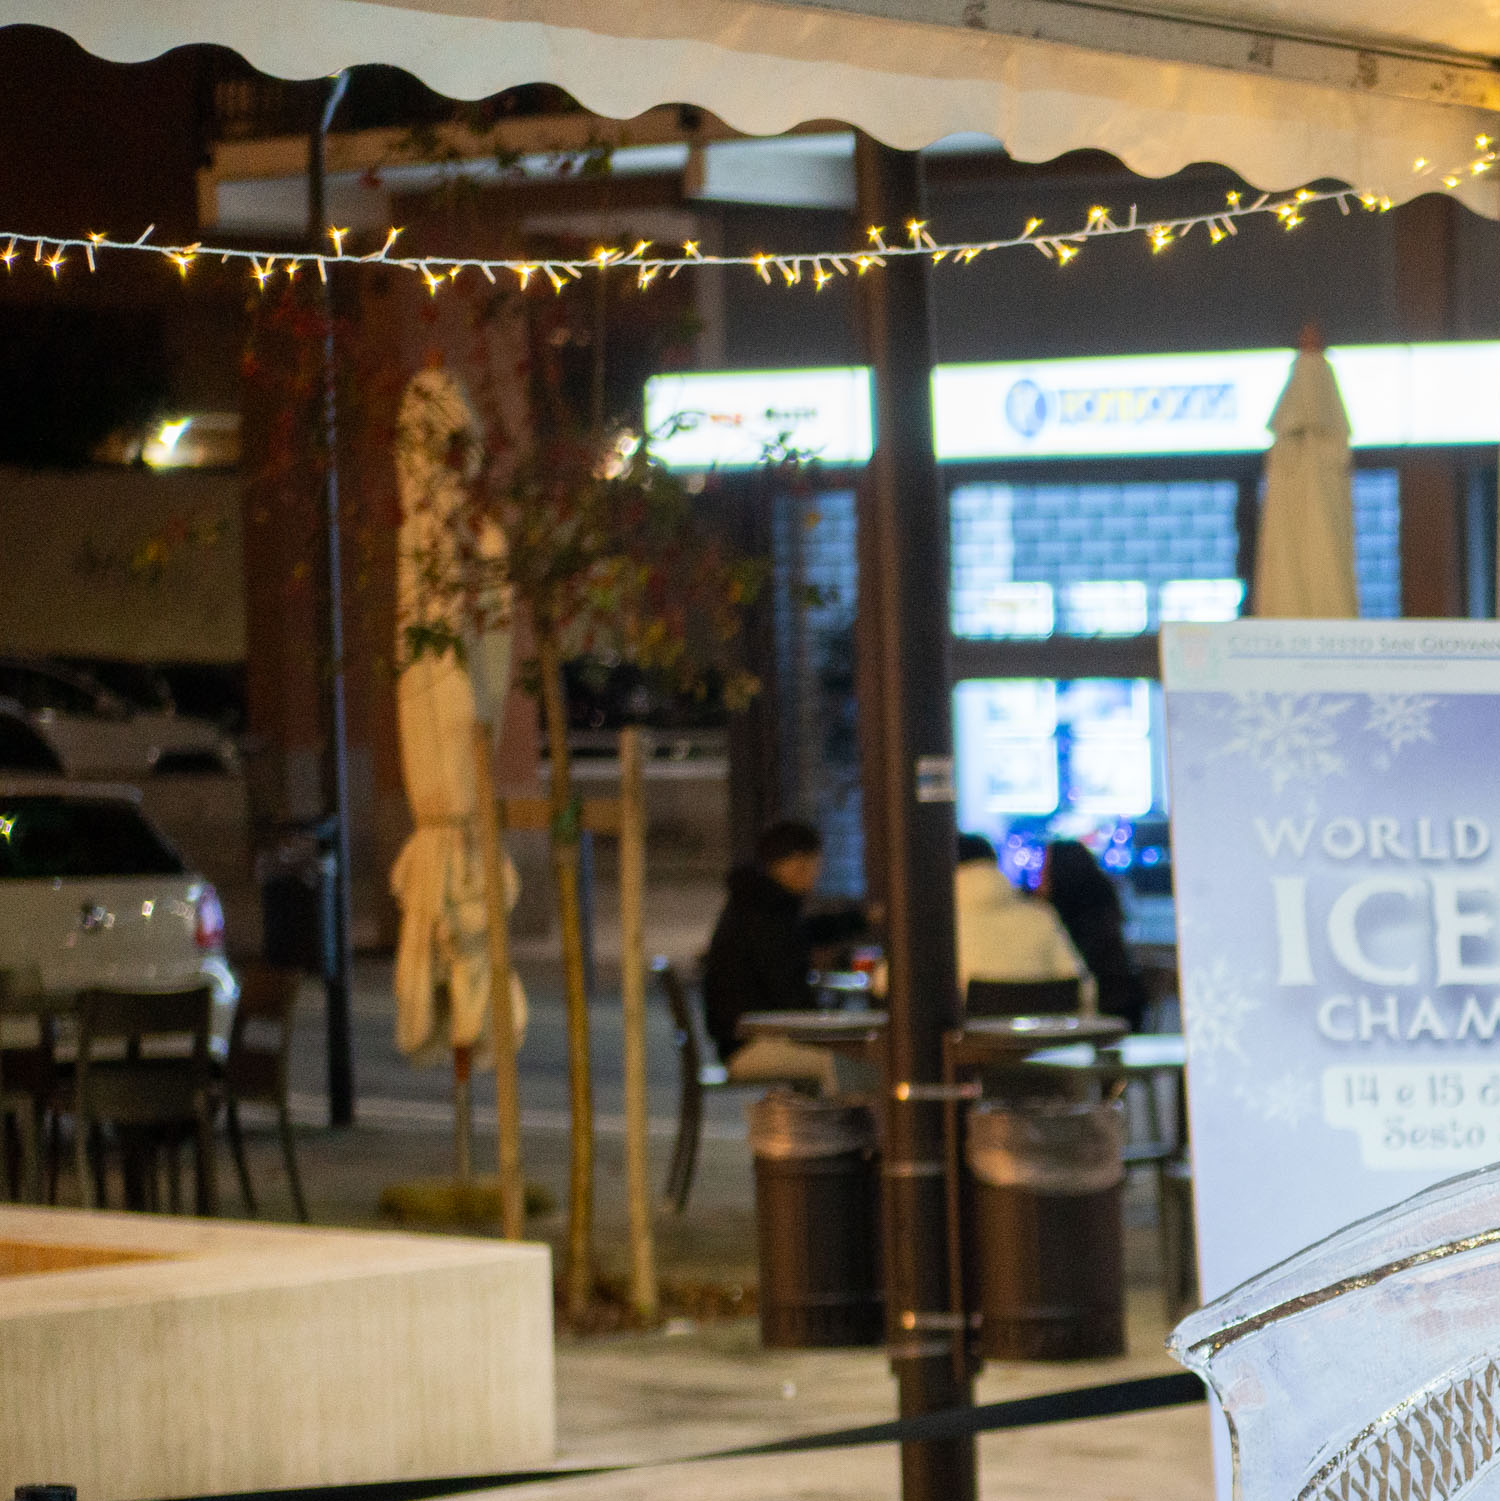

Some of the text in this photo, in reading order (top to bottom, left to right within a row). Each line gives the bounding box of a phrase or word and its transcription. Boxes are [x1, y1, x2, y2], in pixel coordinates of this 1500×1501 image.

[1253, 815, 1493, 860] WORLD
[1344, 1072, 1381, 1106] 14
[1396, 1082, 1416, 1104] e
[1428, 1072, 1466, 1107] 15
[1383, 1114, 1487, 1150] Sesto
